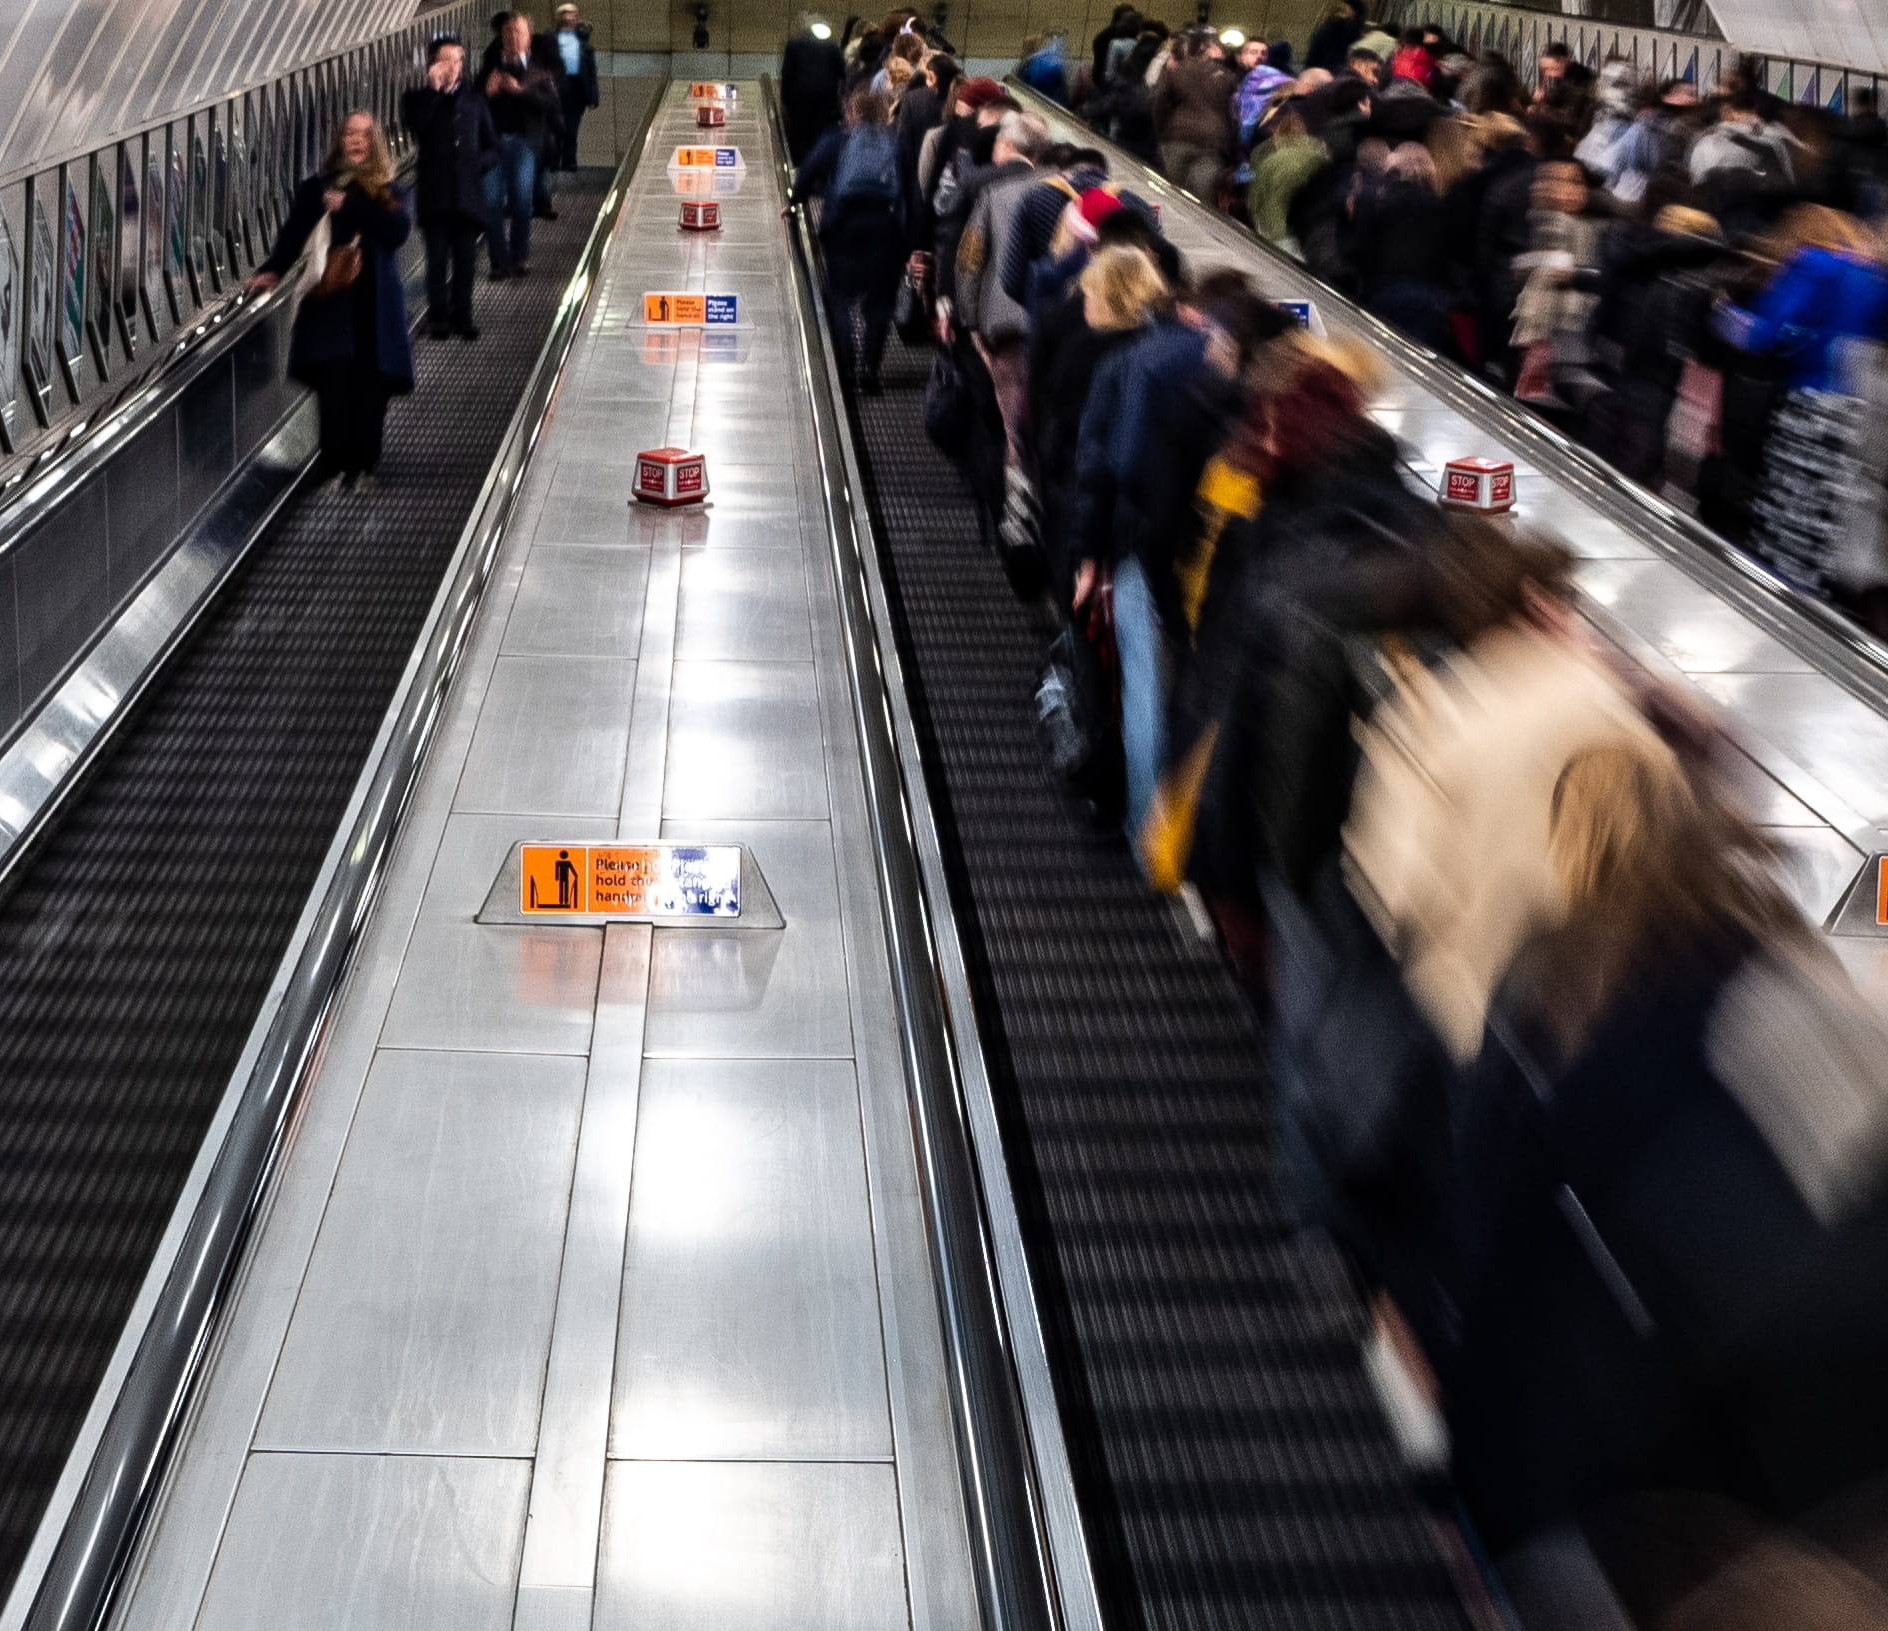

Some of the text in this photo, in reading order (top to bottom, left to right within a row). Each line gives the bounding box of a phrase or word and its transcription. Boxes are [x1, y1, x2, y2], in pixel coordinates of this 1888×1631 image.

[643, 466, 663, 477] STOP
[679, 466, 699, 479] STOP
[1451, 474, 1476, 488] STOP
[1491, 476, 1509, 488] STOP
[595, 858, 640, 871] Please
[595, 874, 626, 886] hold
